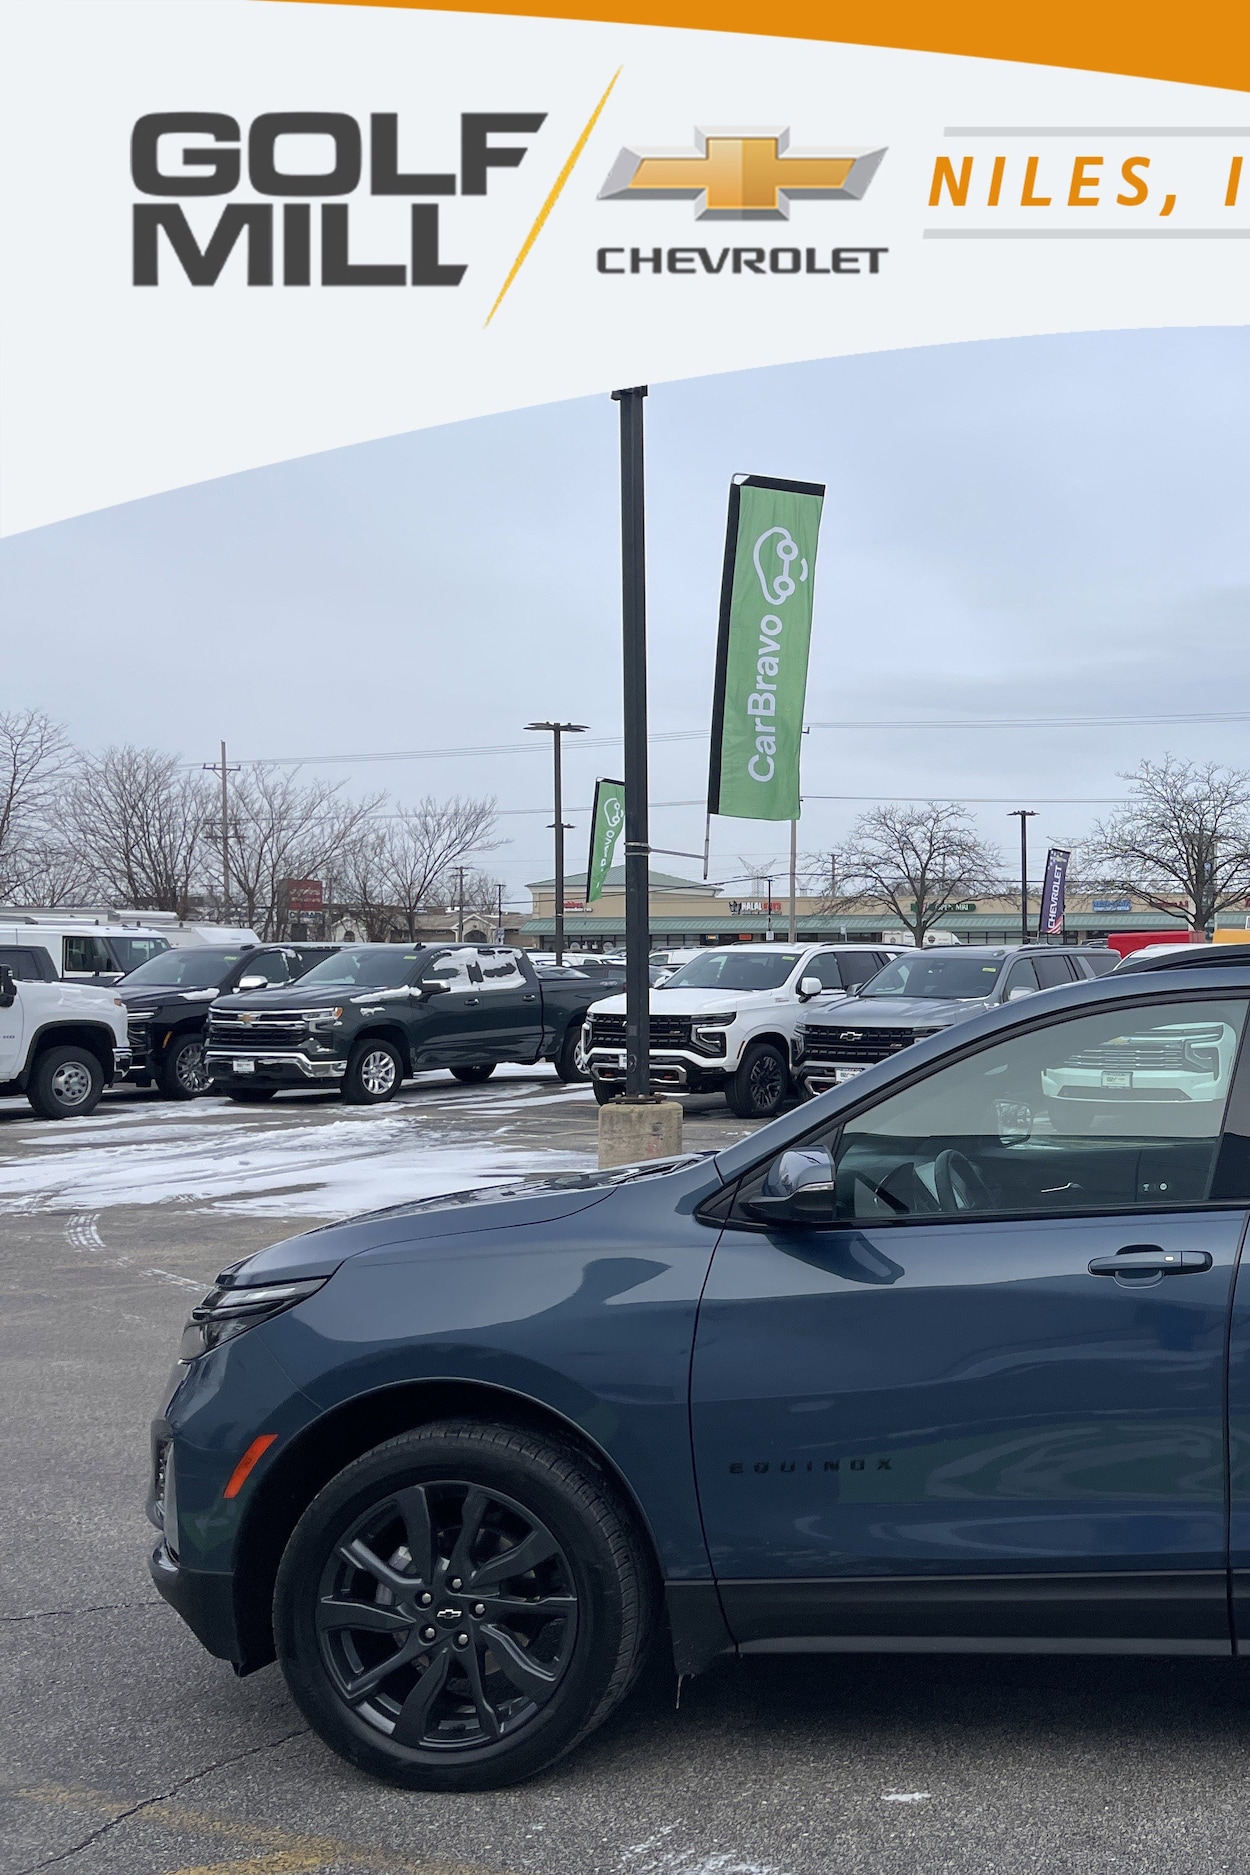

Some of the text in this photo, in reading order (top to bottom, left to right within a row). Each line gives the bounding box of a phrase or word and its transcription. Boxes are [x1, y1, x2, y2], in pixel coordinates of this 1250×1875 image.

[747, 614, 783, 782] CarBravo
[1047, 864, 1063, 929] CHEVROLET
[729, 1458, 893, 1474] EQUINOX
